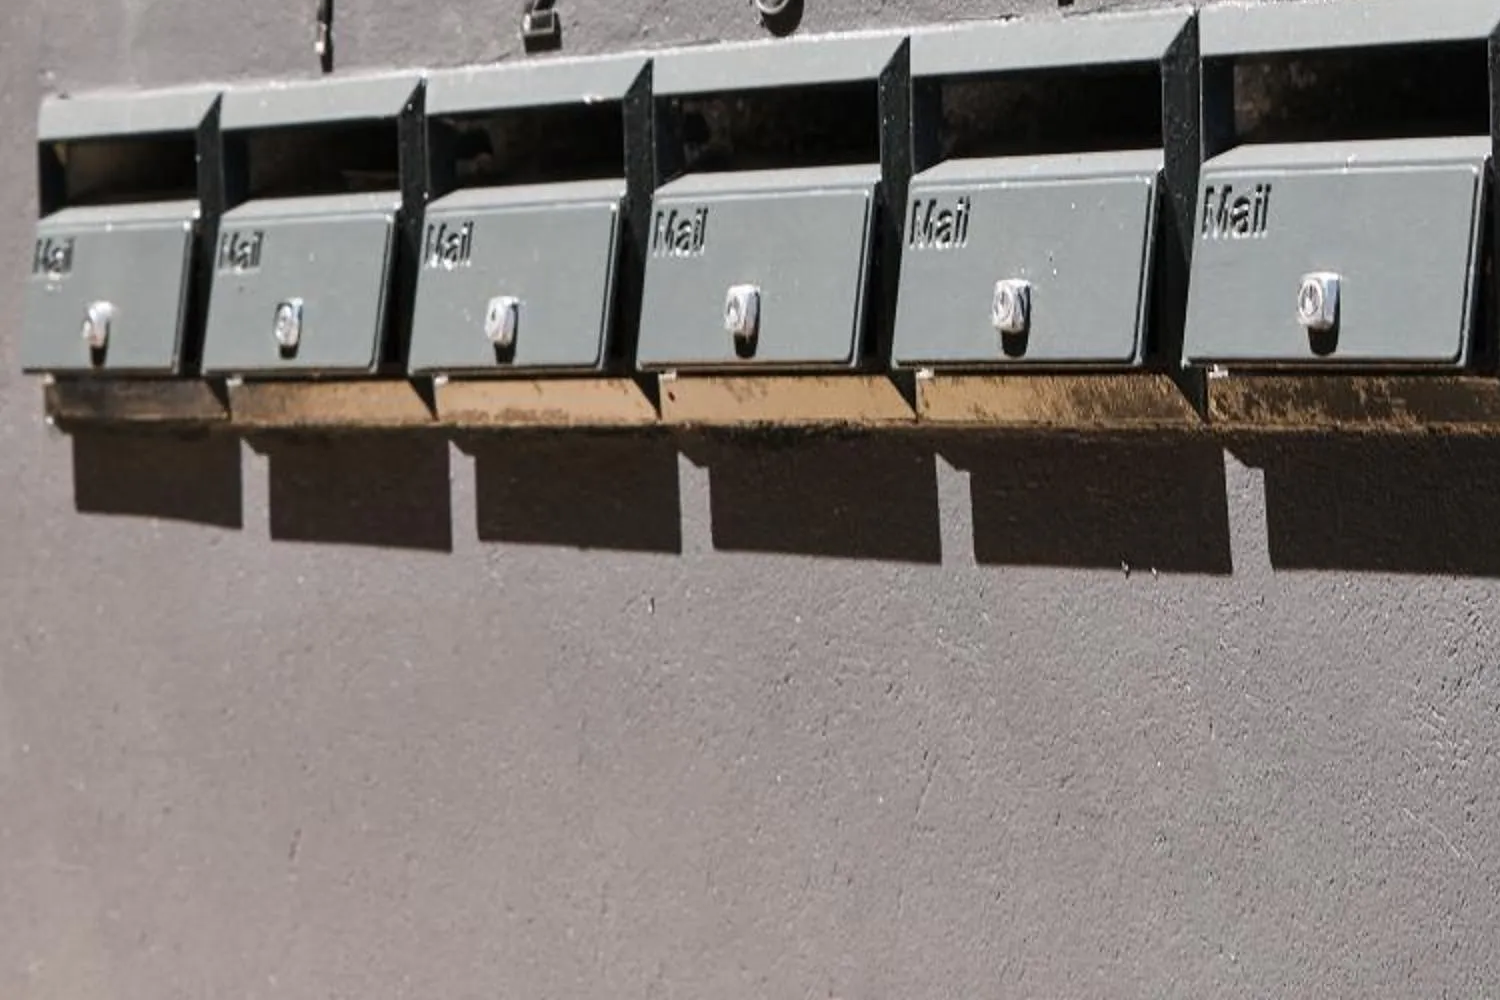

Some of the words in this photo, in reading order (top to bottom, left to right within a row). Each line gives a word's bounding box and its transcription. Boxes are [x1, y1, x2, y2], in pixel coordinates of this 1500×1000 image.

[652, 206, 708, 256] Mail
[909, 195, 970, 249] Mail
[1200, 183, 1272, 239] Mail
[424, 220, 474, 268] Mail
